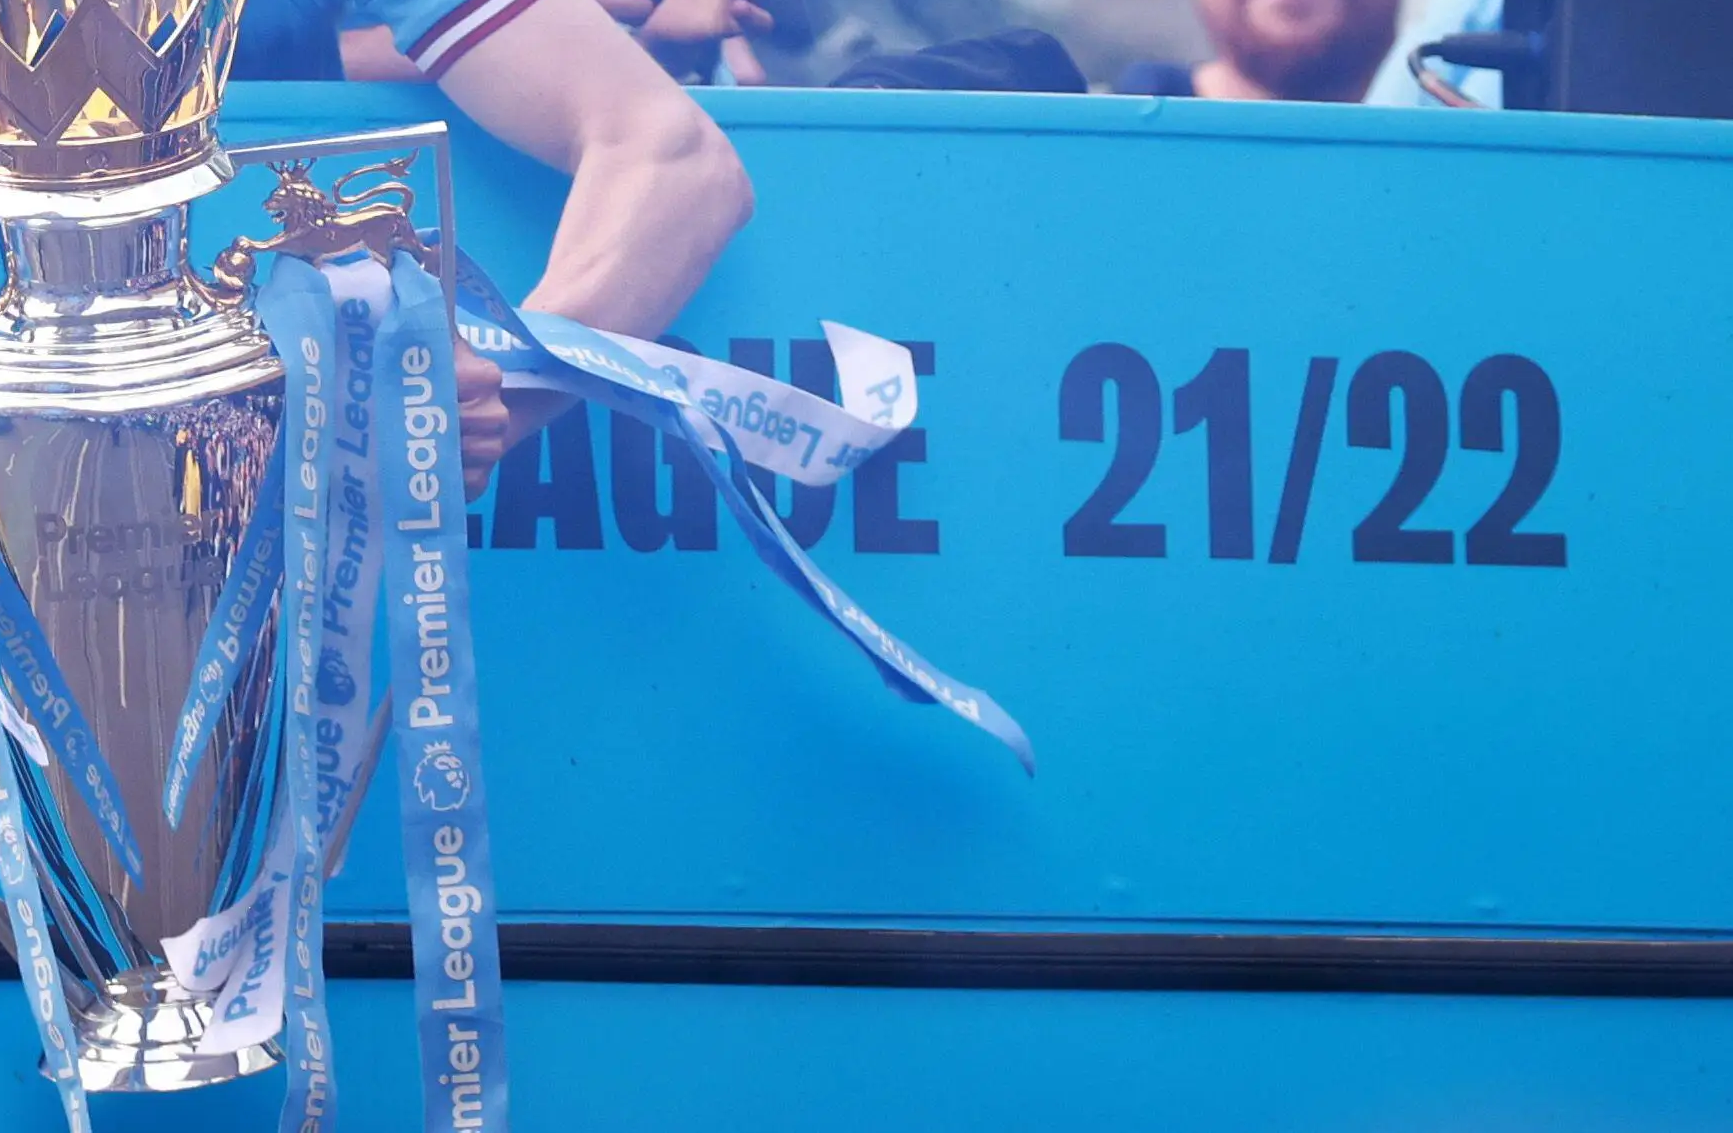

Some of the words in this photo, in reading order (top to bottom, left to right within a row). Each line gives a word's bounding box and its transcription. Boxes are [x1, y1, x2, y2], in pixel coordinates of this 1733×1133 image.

[293, 337, 327, 520] League
[334, 298, 375, 458] League
[398, 346, 447, 533] League
[467, 335, 941, 555] AGUE
[1059, 342, 1567, 568] 21/22
[543, 344, 690, 406] Premie
[699, 389, 822, 469] League
[294, 531, 318, 716] Premier
[323, 466, 369, 636] Premier
[404, 543, 454, 729] Premier
[17, 897, 74, 1079] League
[292, 816, 318, 998] League
[432, 826, 481, 1011] League
[299, 1011, 328, 1133] emier
[438, 1023, 481, 1133] mier
